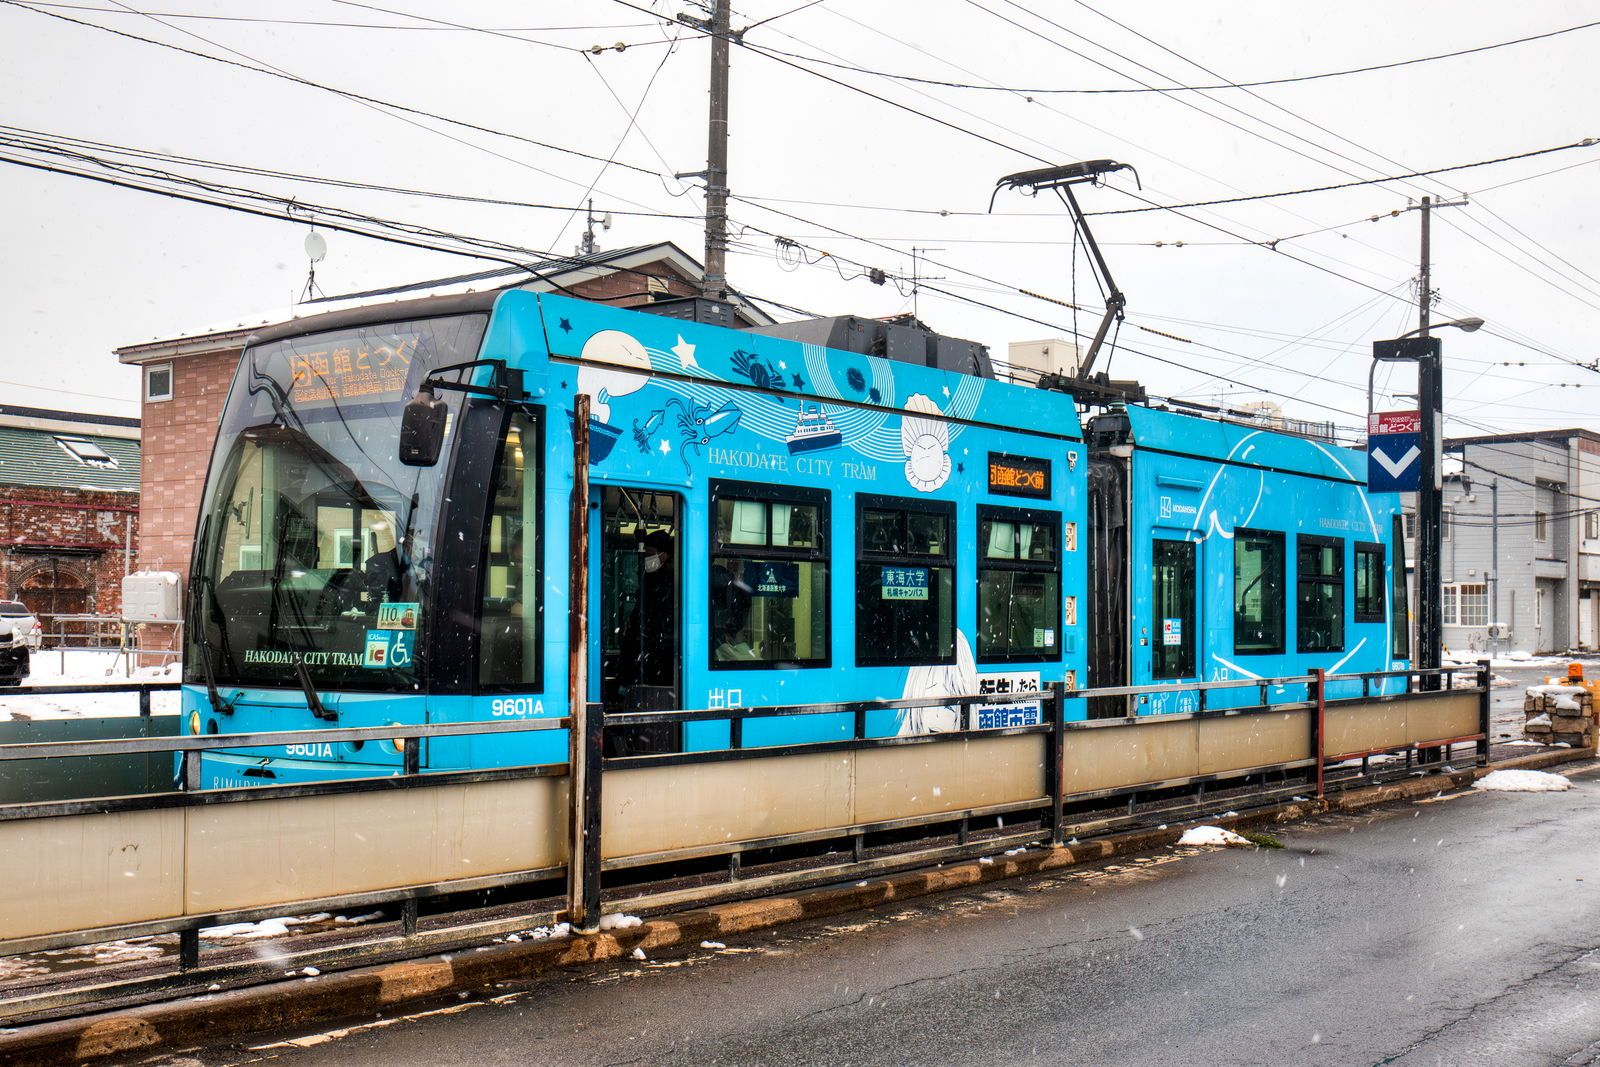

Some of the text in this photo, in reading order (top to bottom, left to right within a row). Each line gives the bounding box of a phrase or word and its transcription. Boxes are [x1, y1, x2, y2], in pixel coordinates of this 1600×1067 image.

[708, 447, 877, 481] HAKODATE CITY TRAM
[886, 569, 925, 586] 東海大学
[887, 587, 924, 598] 札幌キャンパス
[244, 650, 364, 666] HAKODAT CITY TRAM
[1211, 667, 1228, 682] 入口
[708, 688, 742, 709] 出口
[491, 697, 545, 717] 9601A
[285, 742, 333, 757] 9601A
